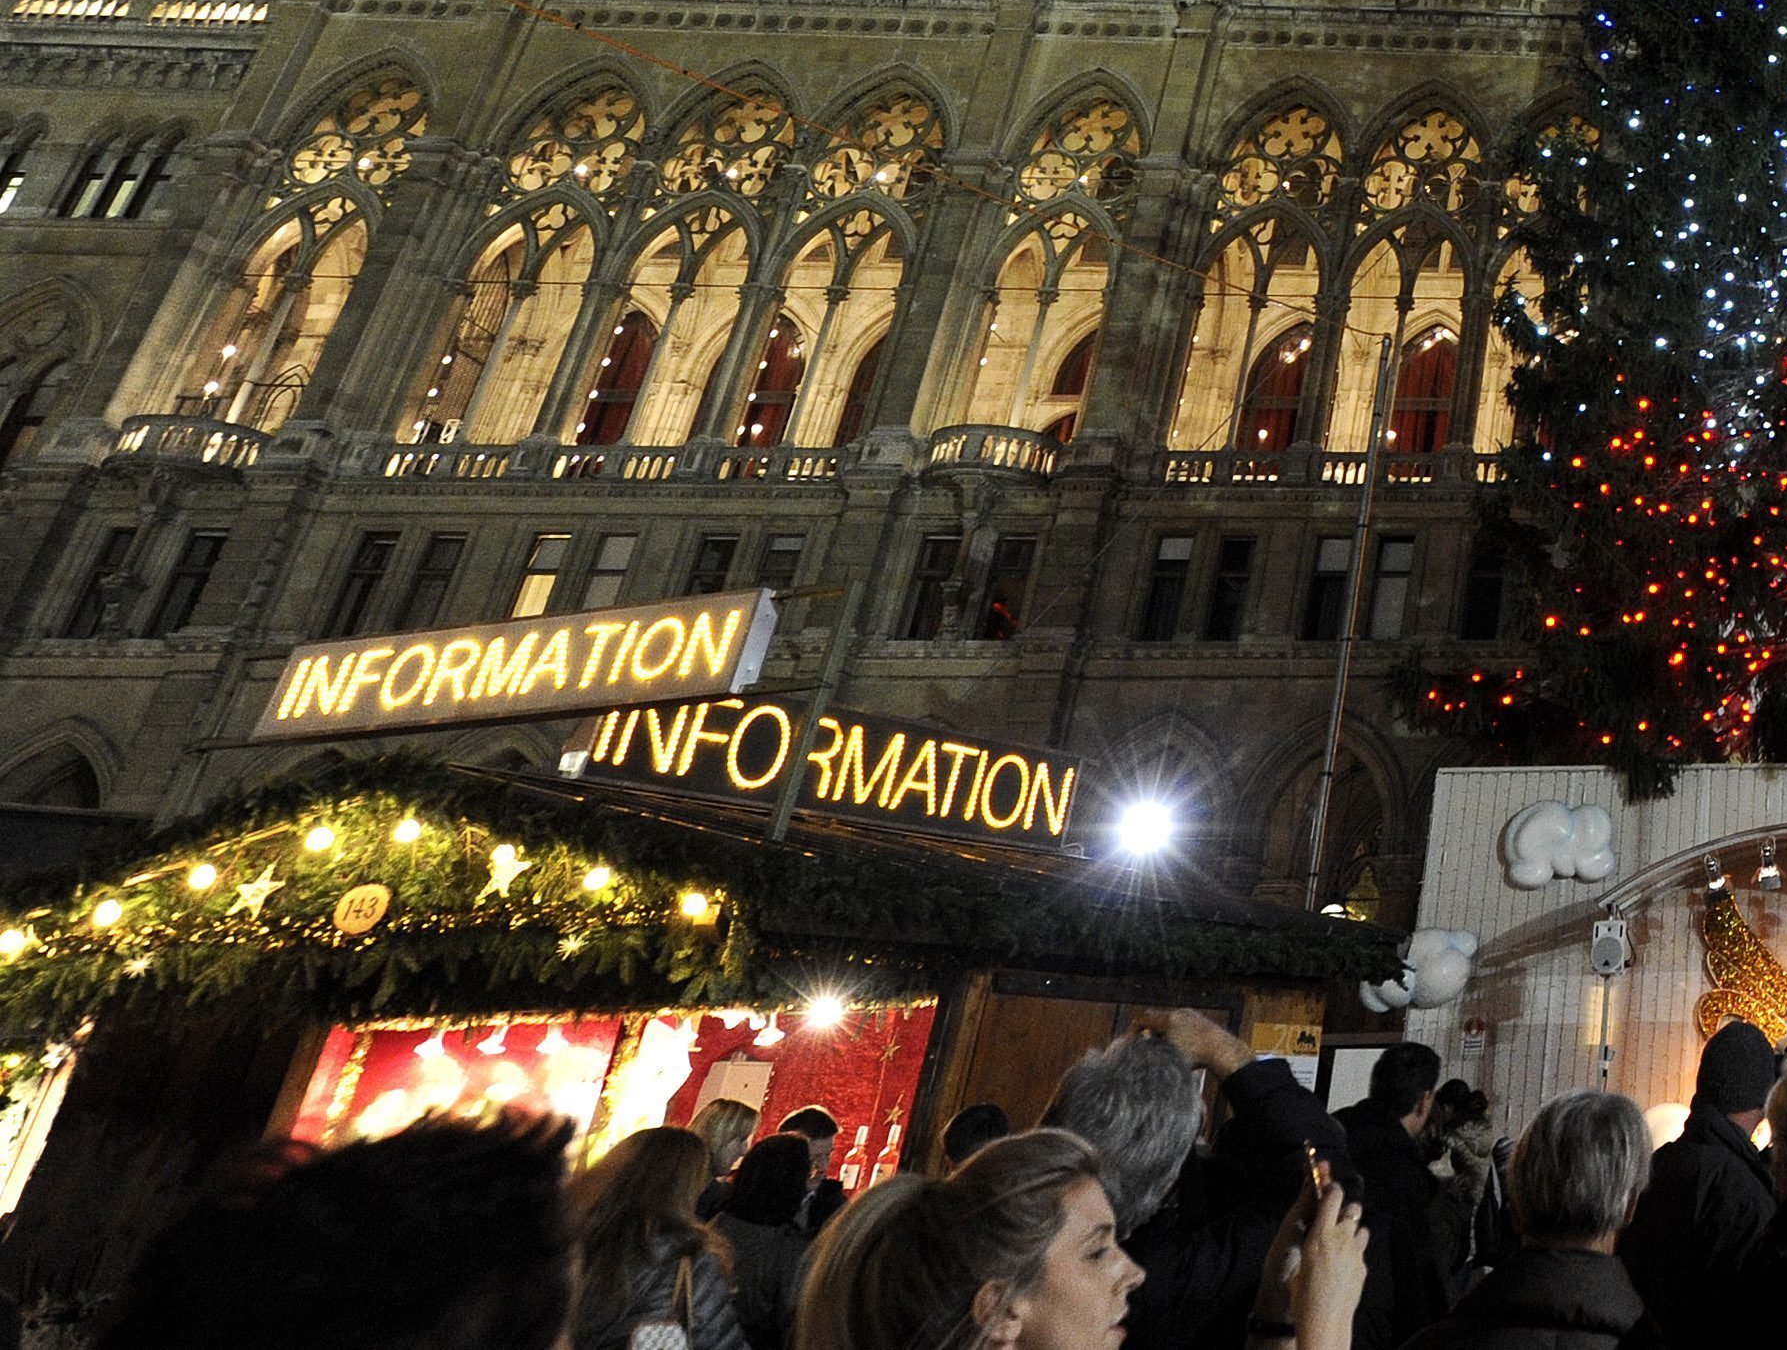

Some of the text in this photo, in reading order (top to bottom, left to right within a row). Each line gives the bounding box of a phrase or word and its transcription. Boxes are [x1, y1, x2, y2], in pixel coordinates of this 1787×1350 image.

[276, 609, 742, 721] INFORMATION
[592, 698, 1075, 837] INFORMATION
[343, 897, 378, 920] 143
